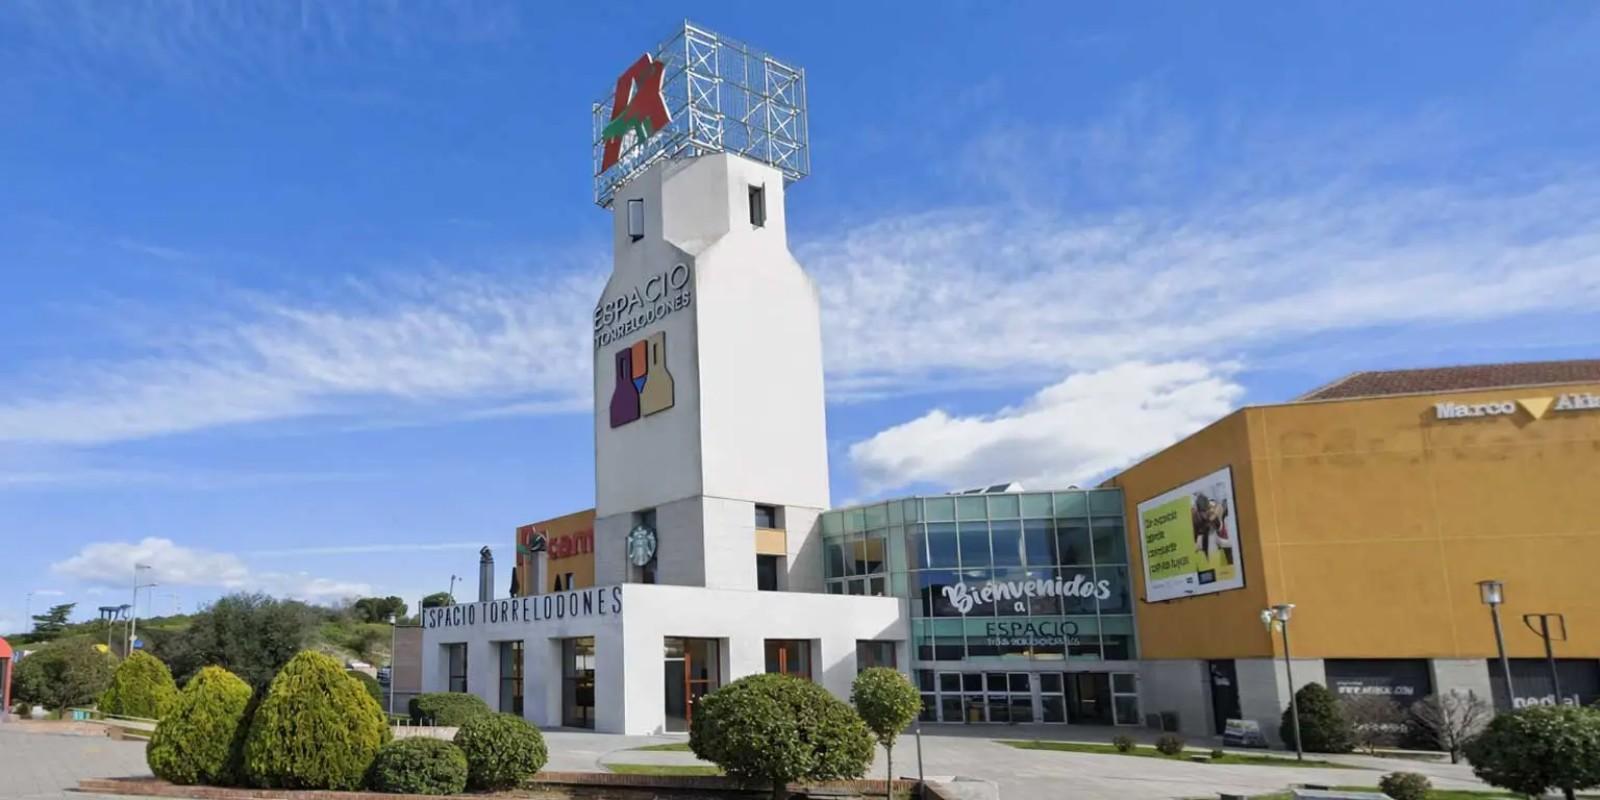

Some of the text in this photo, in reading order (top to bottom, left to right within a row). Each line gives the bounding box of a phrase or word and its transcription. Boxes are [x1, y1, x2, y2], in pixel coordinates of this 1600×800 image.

[593, 262, 691, 332] ESPACIO
[1435, 401, 1516, 419] Marco
[421, 586, 622, 629] ESPACIO TORRELODONES
[942, 574, 1111, 613] Bienvenidos
[1014, 601, 1026, 612] a
[986, 621, 1079, 638] ESPACIO
